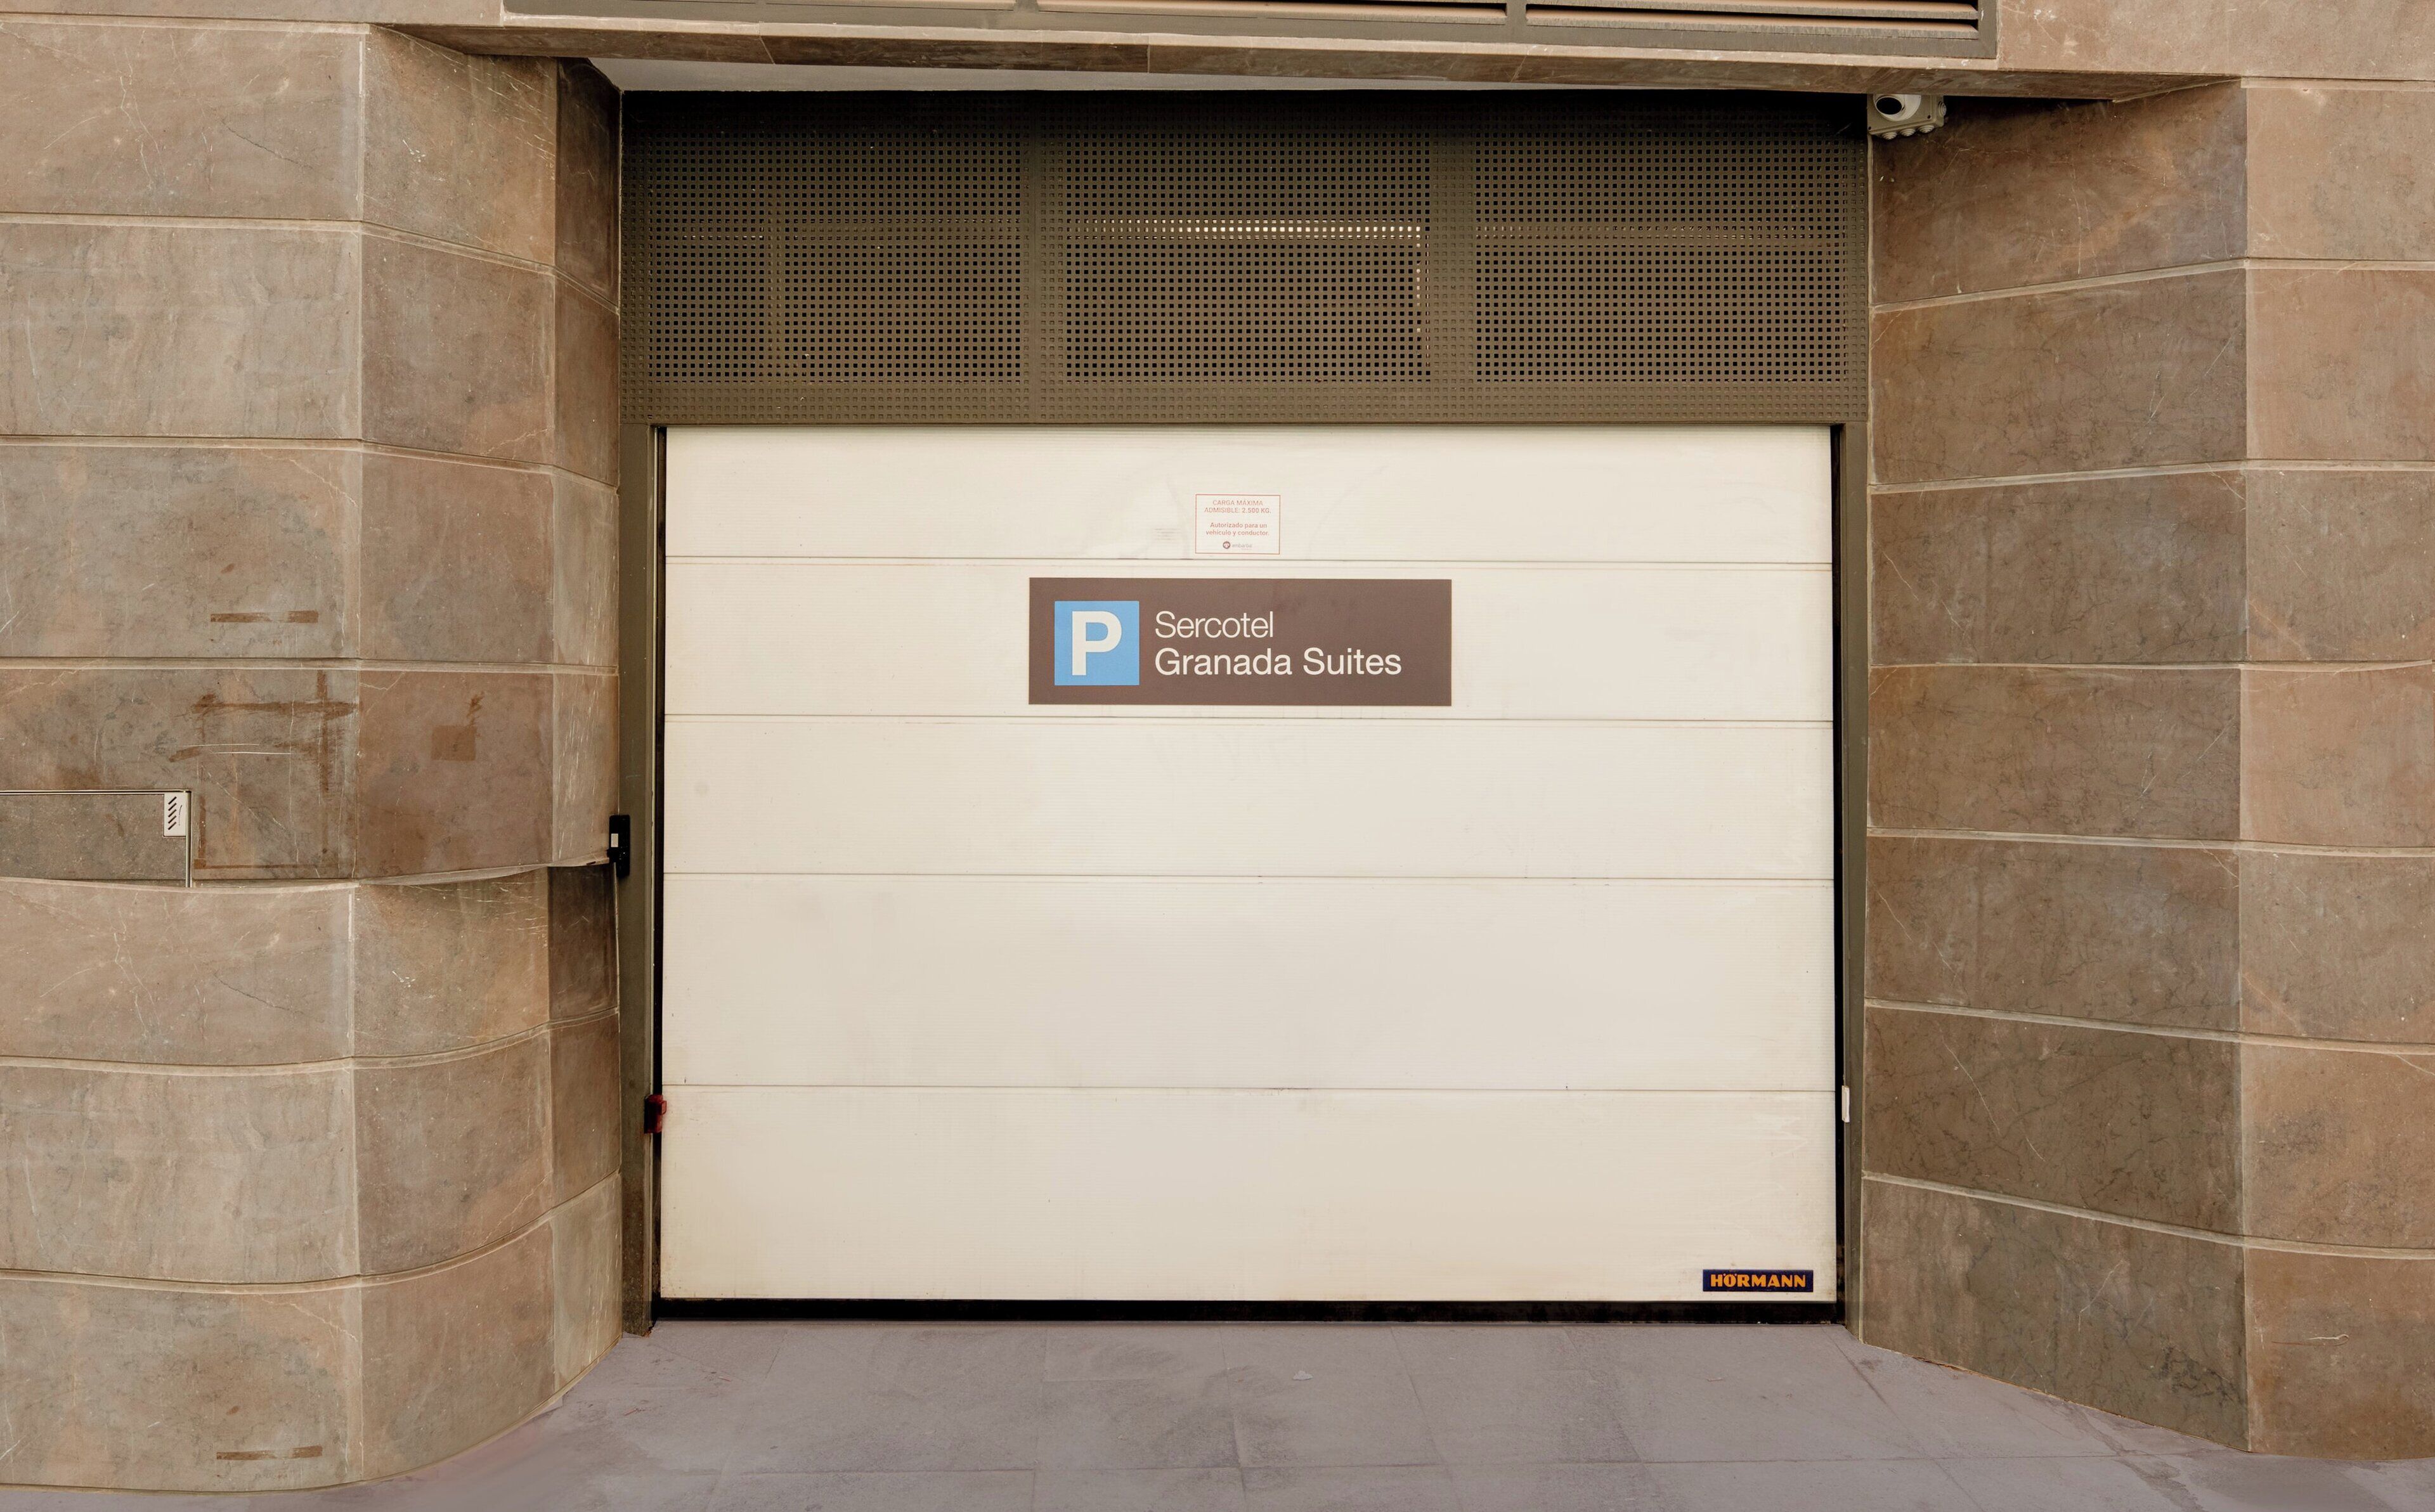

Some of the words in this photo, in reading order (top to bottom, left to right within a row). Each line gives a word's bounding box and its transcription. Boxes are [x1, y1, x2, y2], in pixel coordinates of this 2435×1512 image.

[1155, 611, 1274, 638] Sercotel
[1072, 611, 1122, 676] P
[1155, 648, 1292, 676] Granada
[1302, 647, 1402, 675] Suites
[1710, 1273, 1806, 1288] HÖRMANN
